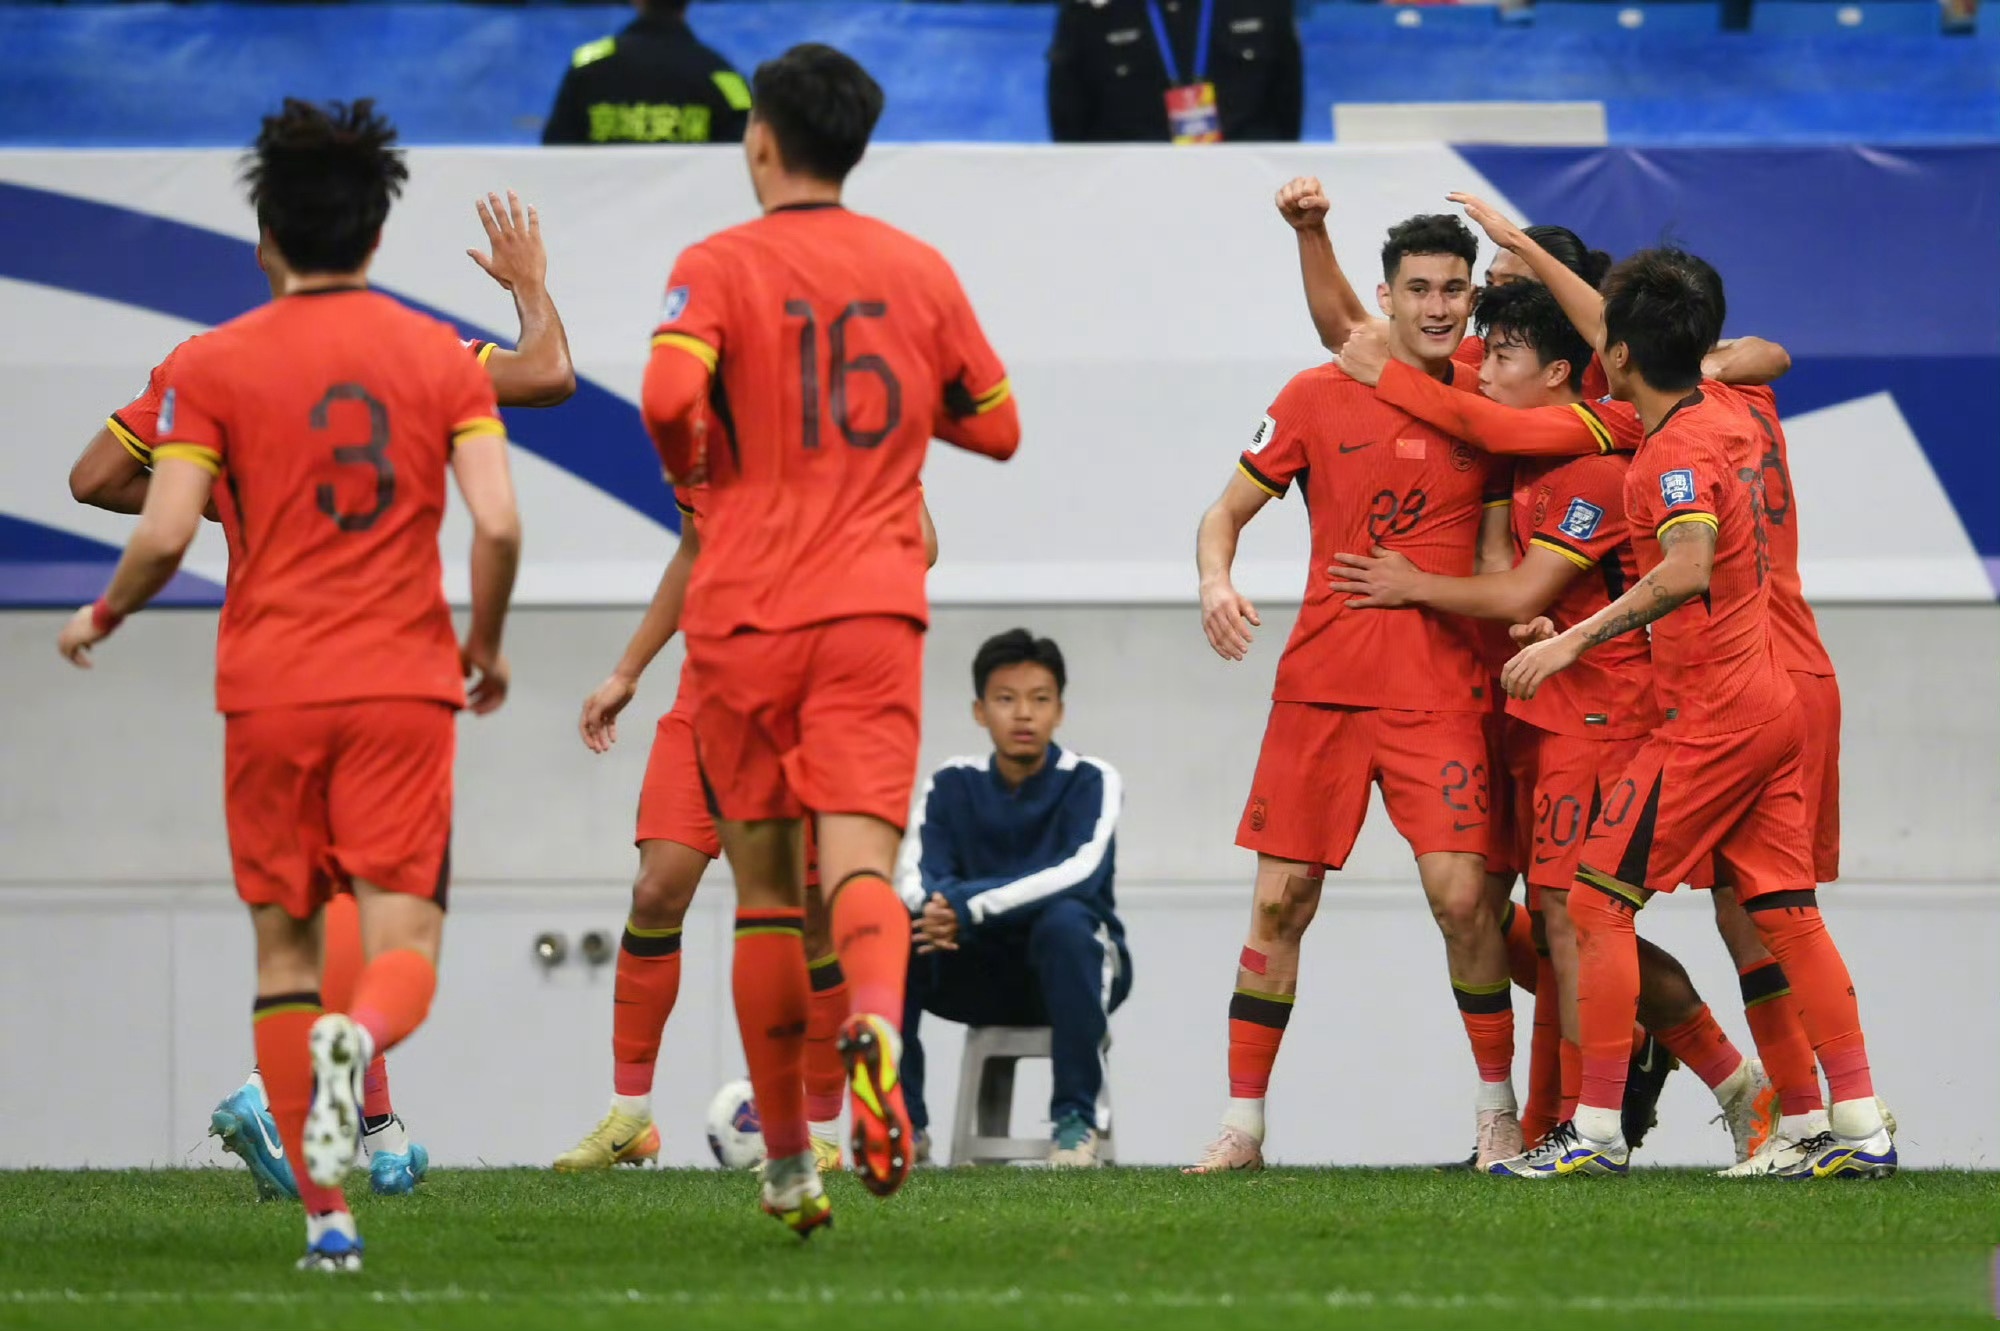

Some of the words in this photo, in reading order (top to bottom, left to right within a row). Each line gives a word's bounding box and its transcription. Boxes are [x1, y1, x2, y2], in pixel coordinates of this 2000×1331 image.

[785, 299, 902, 449] 16
[310, 381, 396, 533] 3
[1368, 488, 1427, 542] 23
[1440, 760, 1488, 814] 23
[1535, 793, 1581, 847] 20
